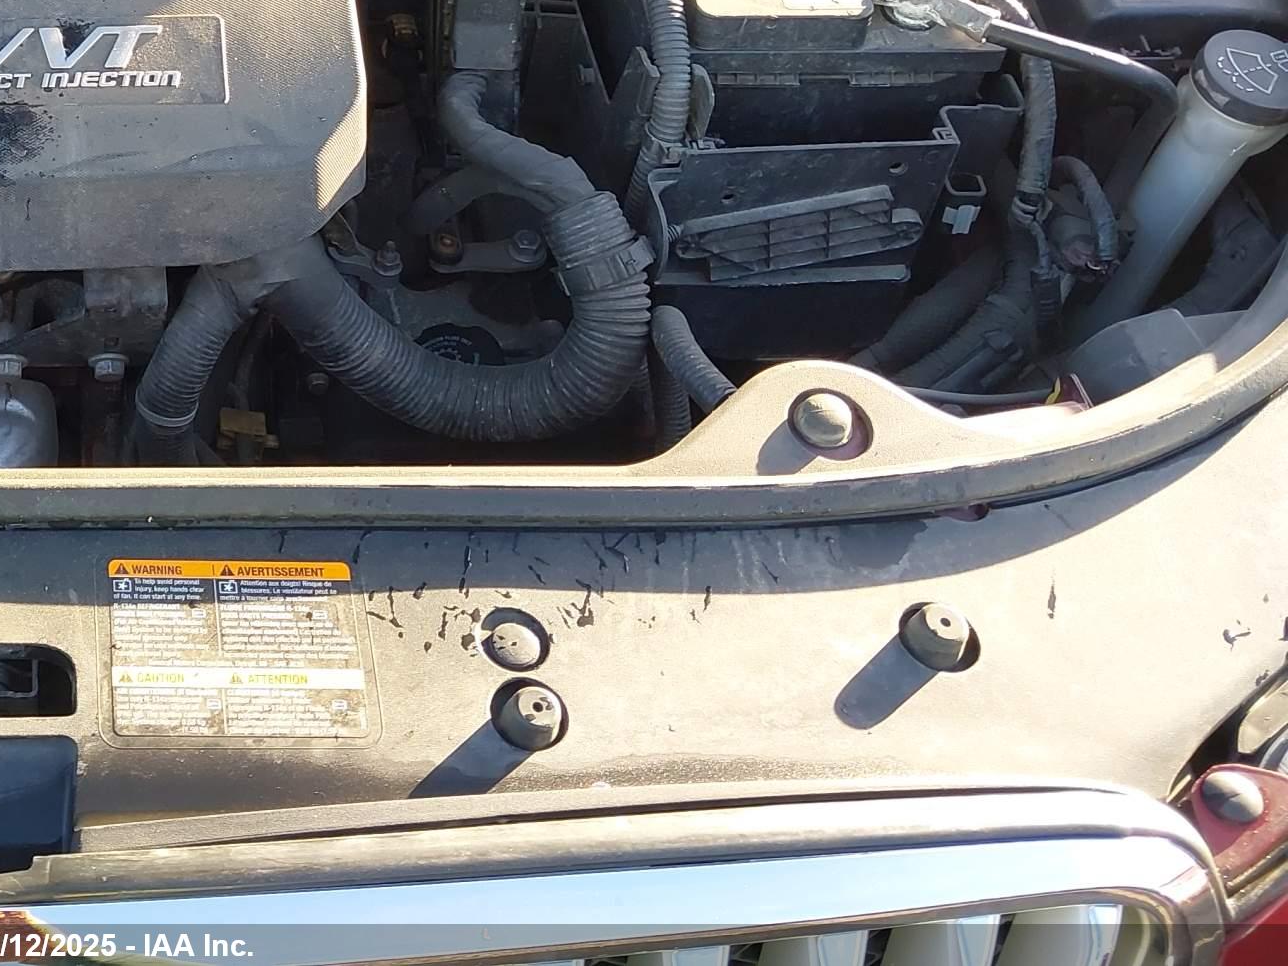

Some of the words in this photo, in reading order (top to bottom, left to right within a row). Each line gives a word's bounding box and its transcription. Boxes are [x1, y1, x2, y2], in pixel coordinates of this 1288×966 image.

[41, 70, 181, 89] INJECTION
[132, 565, 183, 575] WARNING
[237, 566, 325, 577] AVERTISSEMENT
[142, 578, 156, 586] help
[137, 673, 185, 683] CAUTION
[248, 674, 308, 684] ATTENTION
